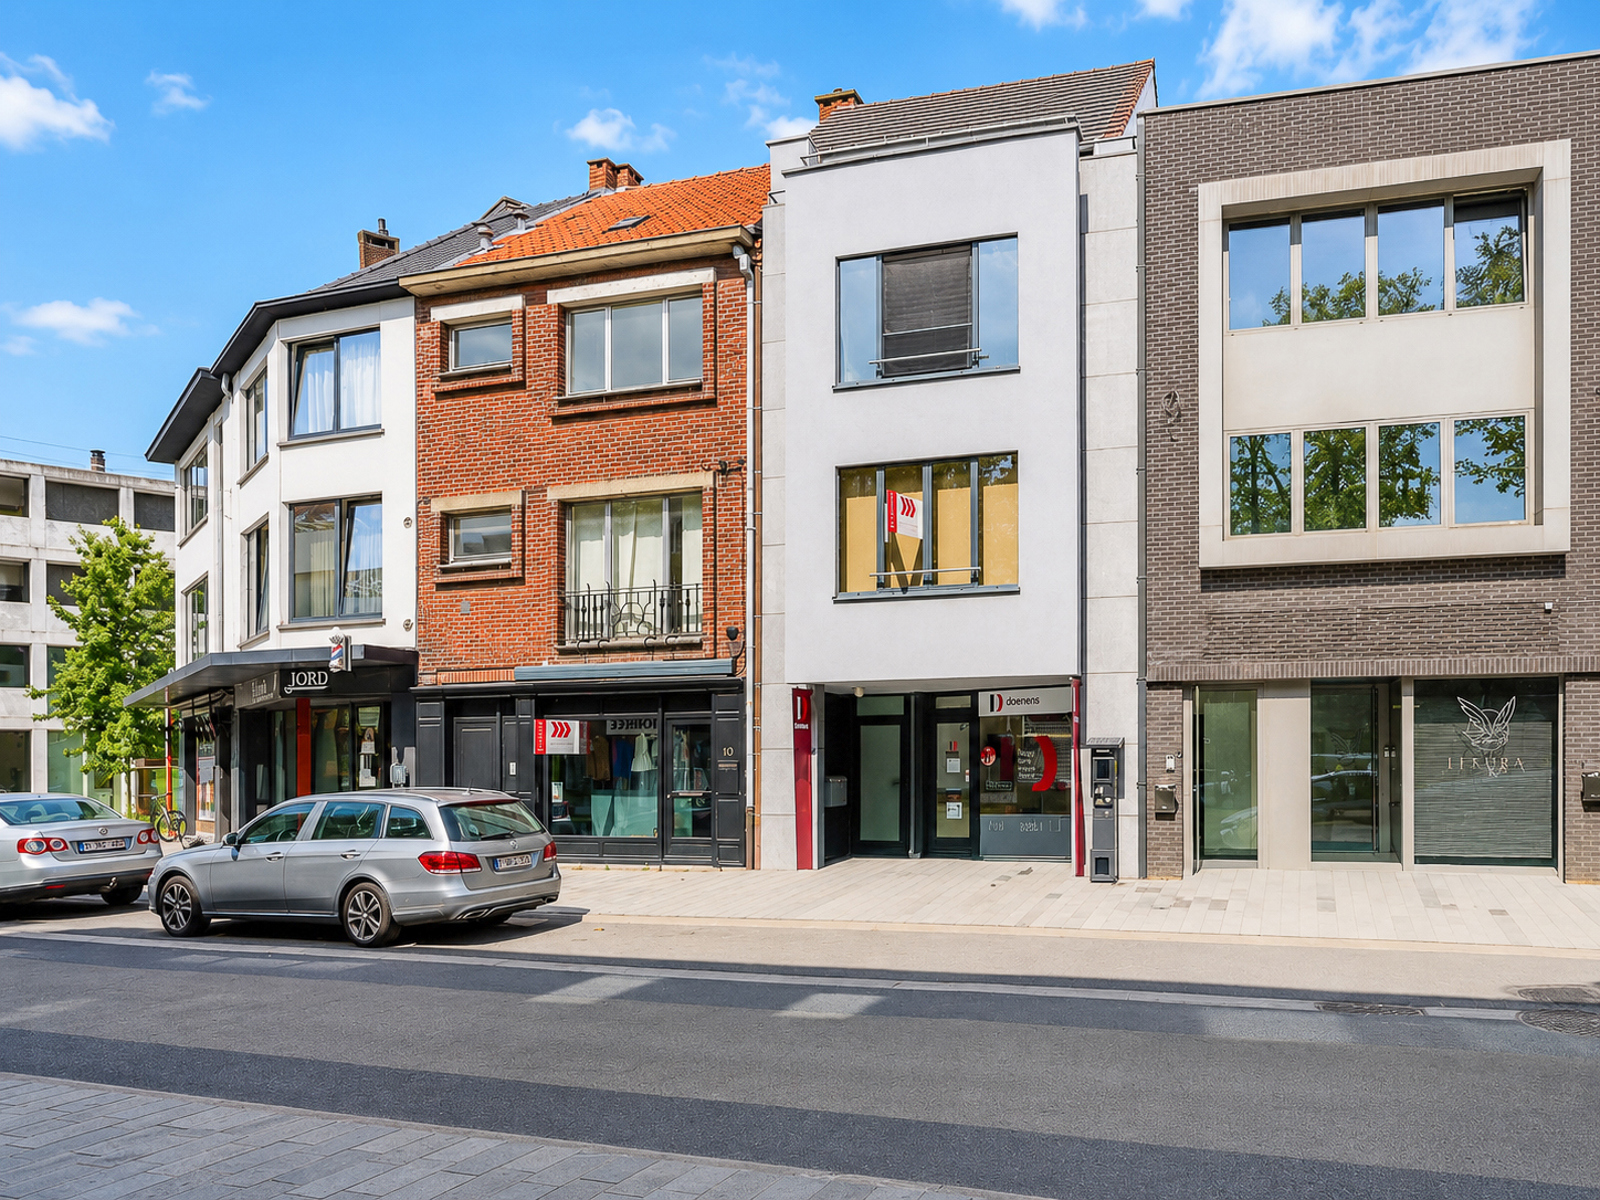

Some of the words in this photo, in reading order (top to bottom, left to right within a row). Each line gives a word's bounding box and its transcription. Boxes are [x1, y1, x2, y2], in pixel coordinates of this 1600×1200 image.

[289, 671, 328, 688] JORD
[1006, 696, 1040, 706] doenens
[722, 746, 734, 757] 10
